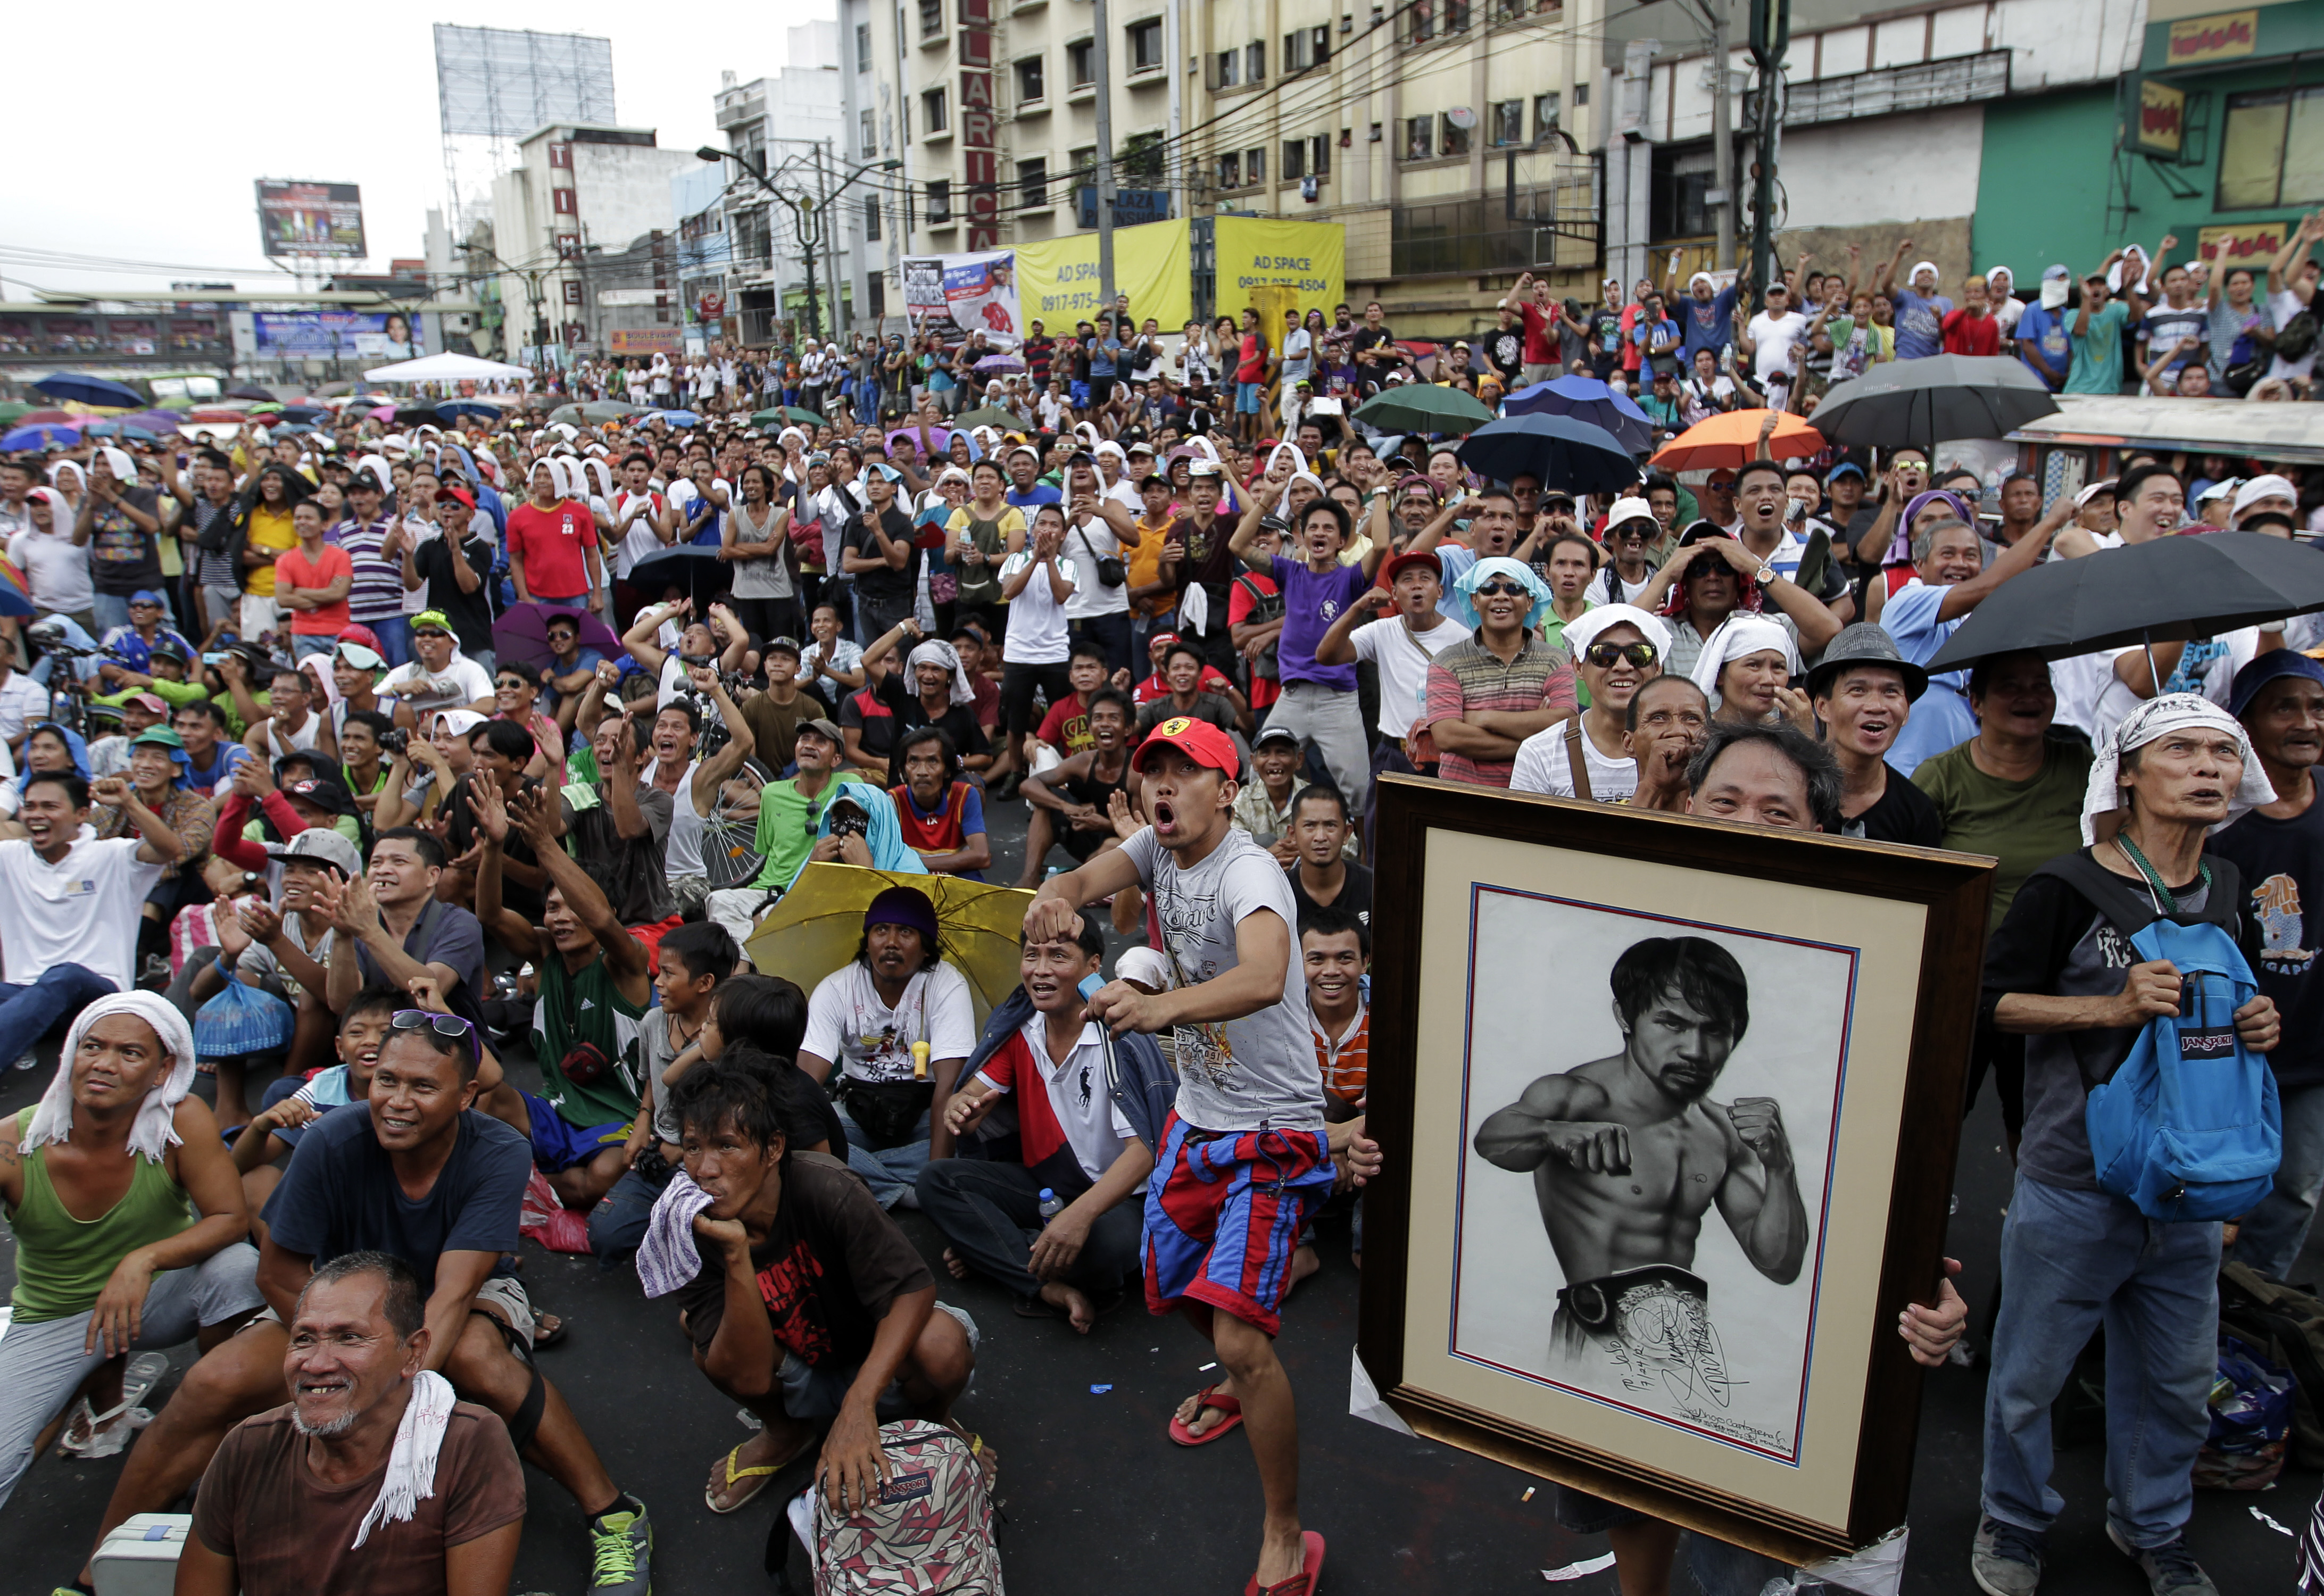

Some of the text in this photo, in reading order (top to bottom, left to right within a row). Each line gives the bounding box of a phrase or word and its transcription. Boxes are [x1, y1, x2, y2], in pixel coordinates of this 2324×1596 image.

[1115, 193, 1155, 209] LAZA
[1252, 255, 1312, 271] AD SPACE
[1057, 261, 1101, 282] AD SPAC
[562, 523, 575, 535] 23
[926, 816, 938, 826] IX
[2261, 946, 2323, 975] GAPO
[2181, 1034, 2233, 1051] JANSPORT
[883, 1477, 928, 1499] JANSPORT
